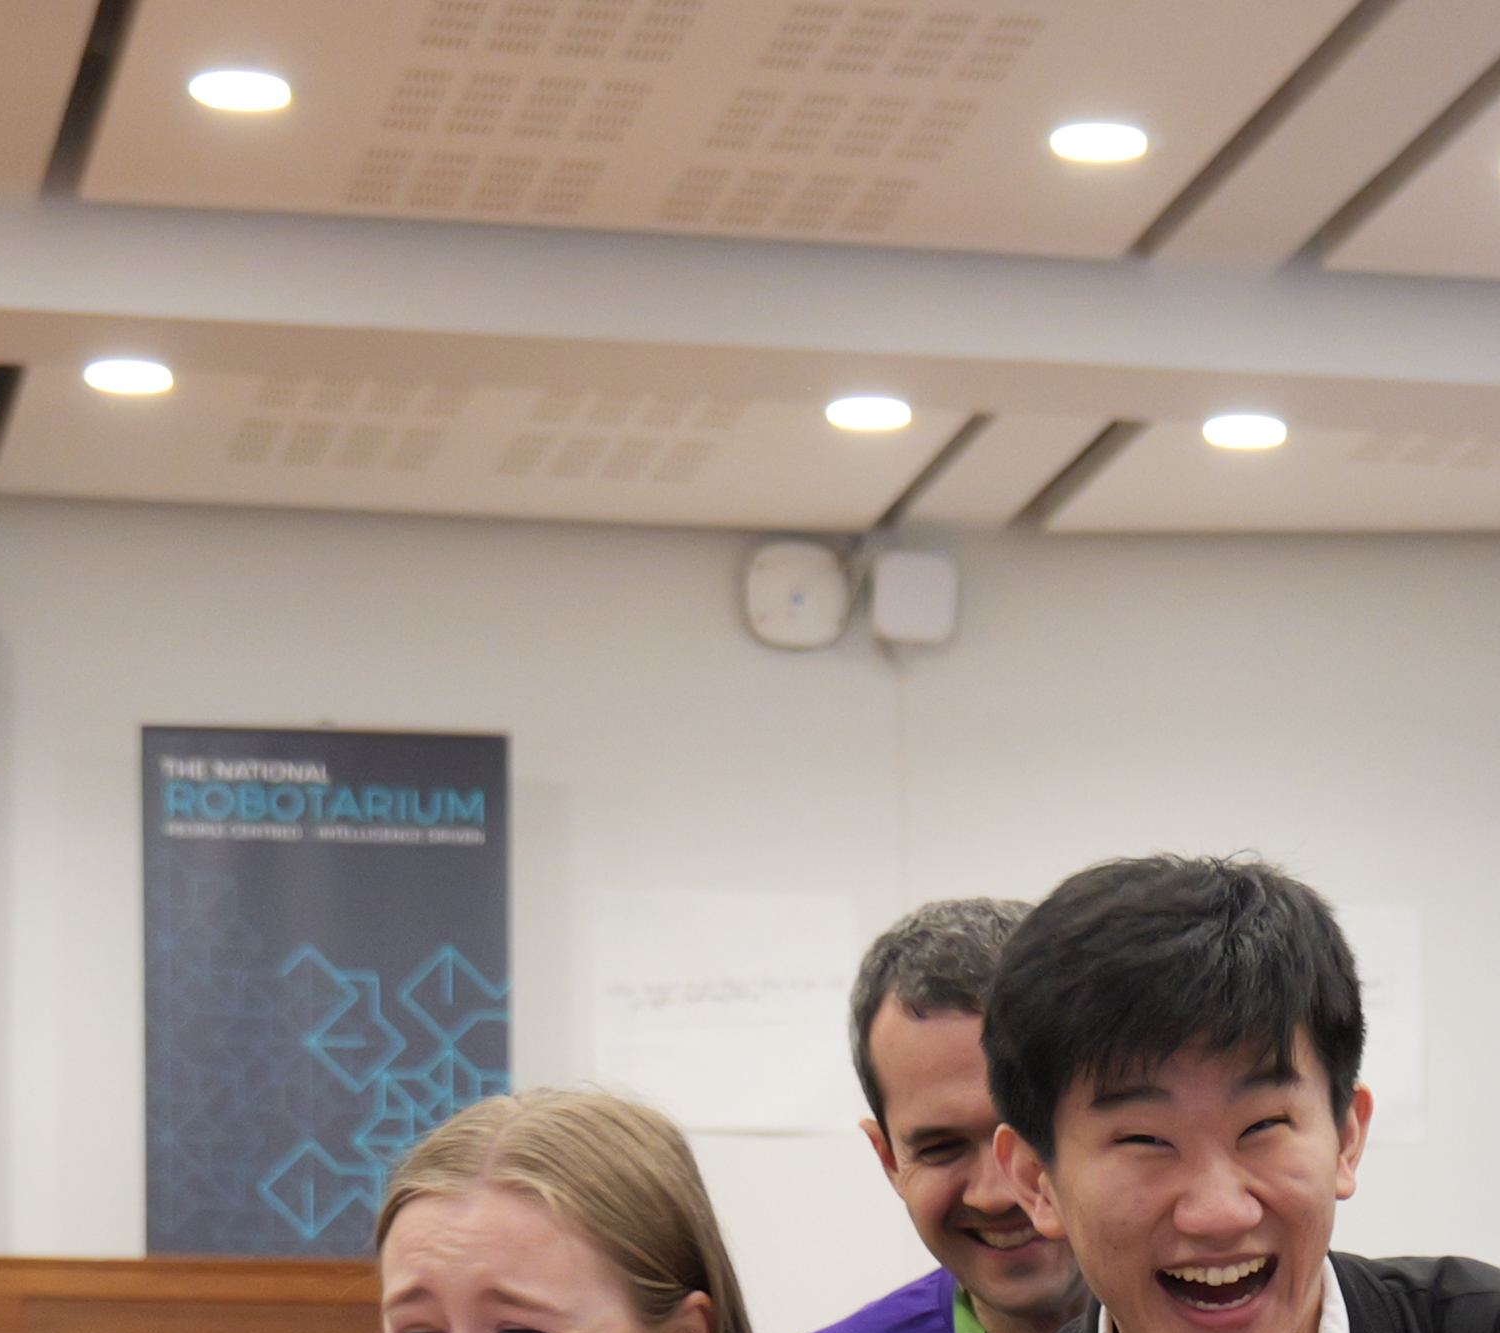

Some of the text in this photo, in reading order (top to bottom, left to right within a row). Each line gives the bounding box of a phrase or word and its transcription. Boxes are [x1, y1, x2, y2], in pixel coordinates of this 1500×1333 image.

[161, 756, 332, 784] THE NATIONAL
[164, 782, 487, 827] ROBOTARIUM
